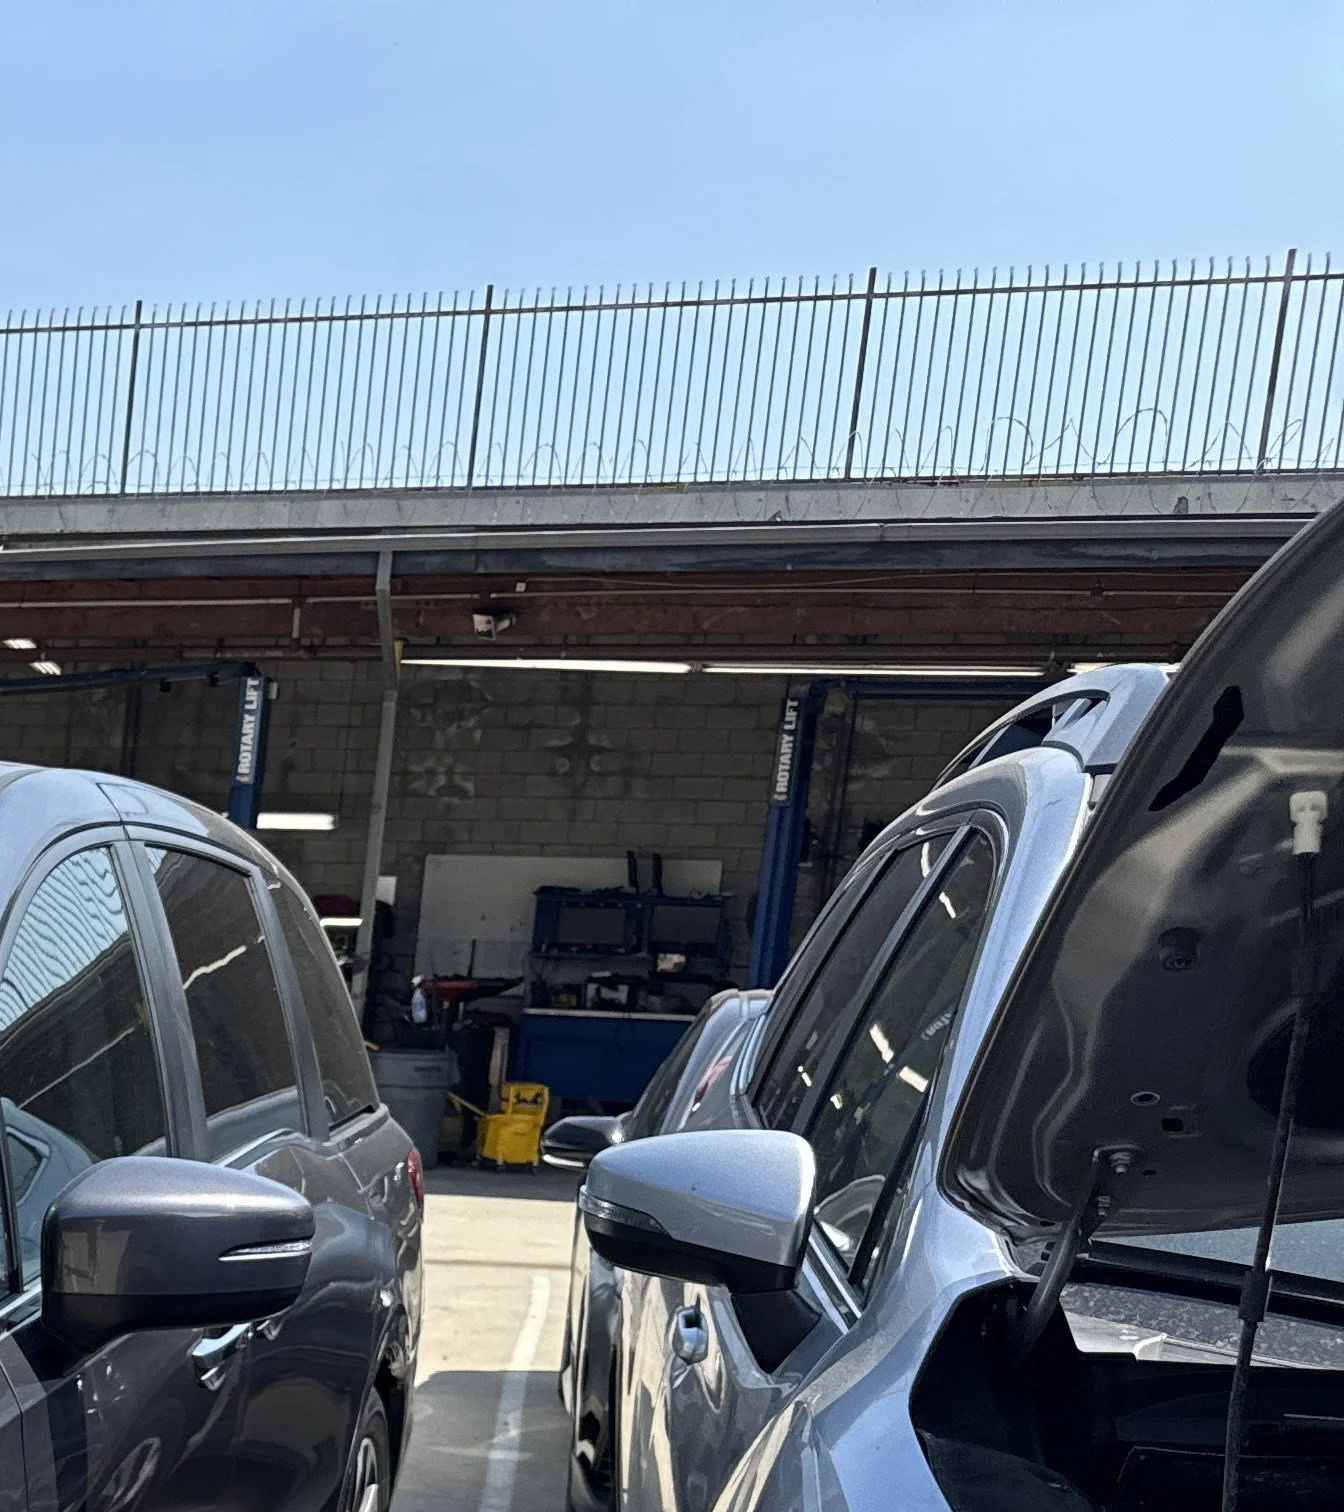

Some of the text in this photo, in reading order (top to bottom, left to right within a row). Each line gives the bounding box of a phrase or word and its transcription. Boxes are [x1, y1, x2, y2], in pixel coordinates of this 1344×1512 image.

[237, 678, 260, 774] ROTARY LIFT
[775, 699, 799, 792] ROTARY LIFT
